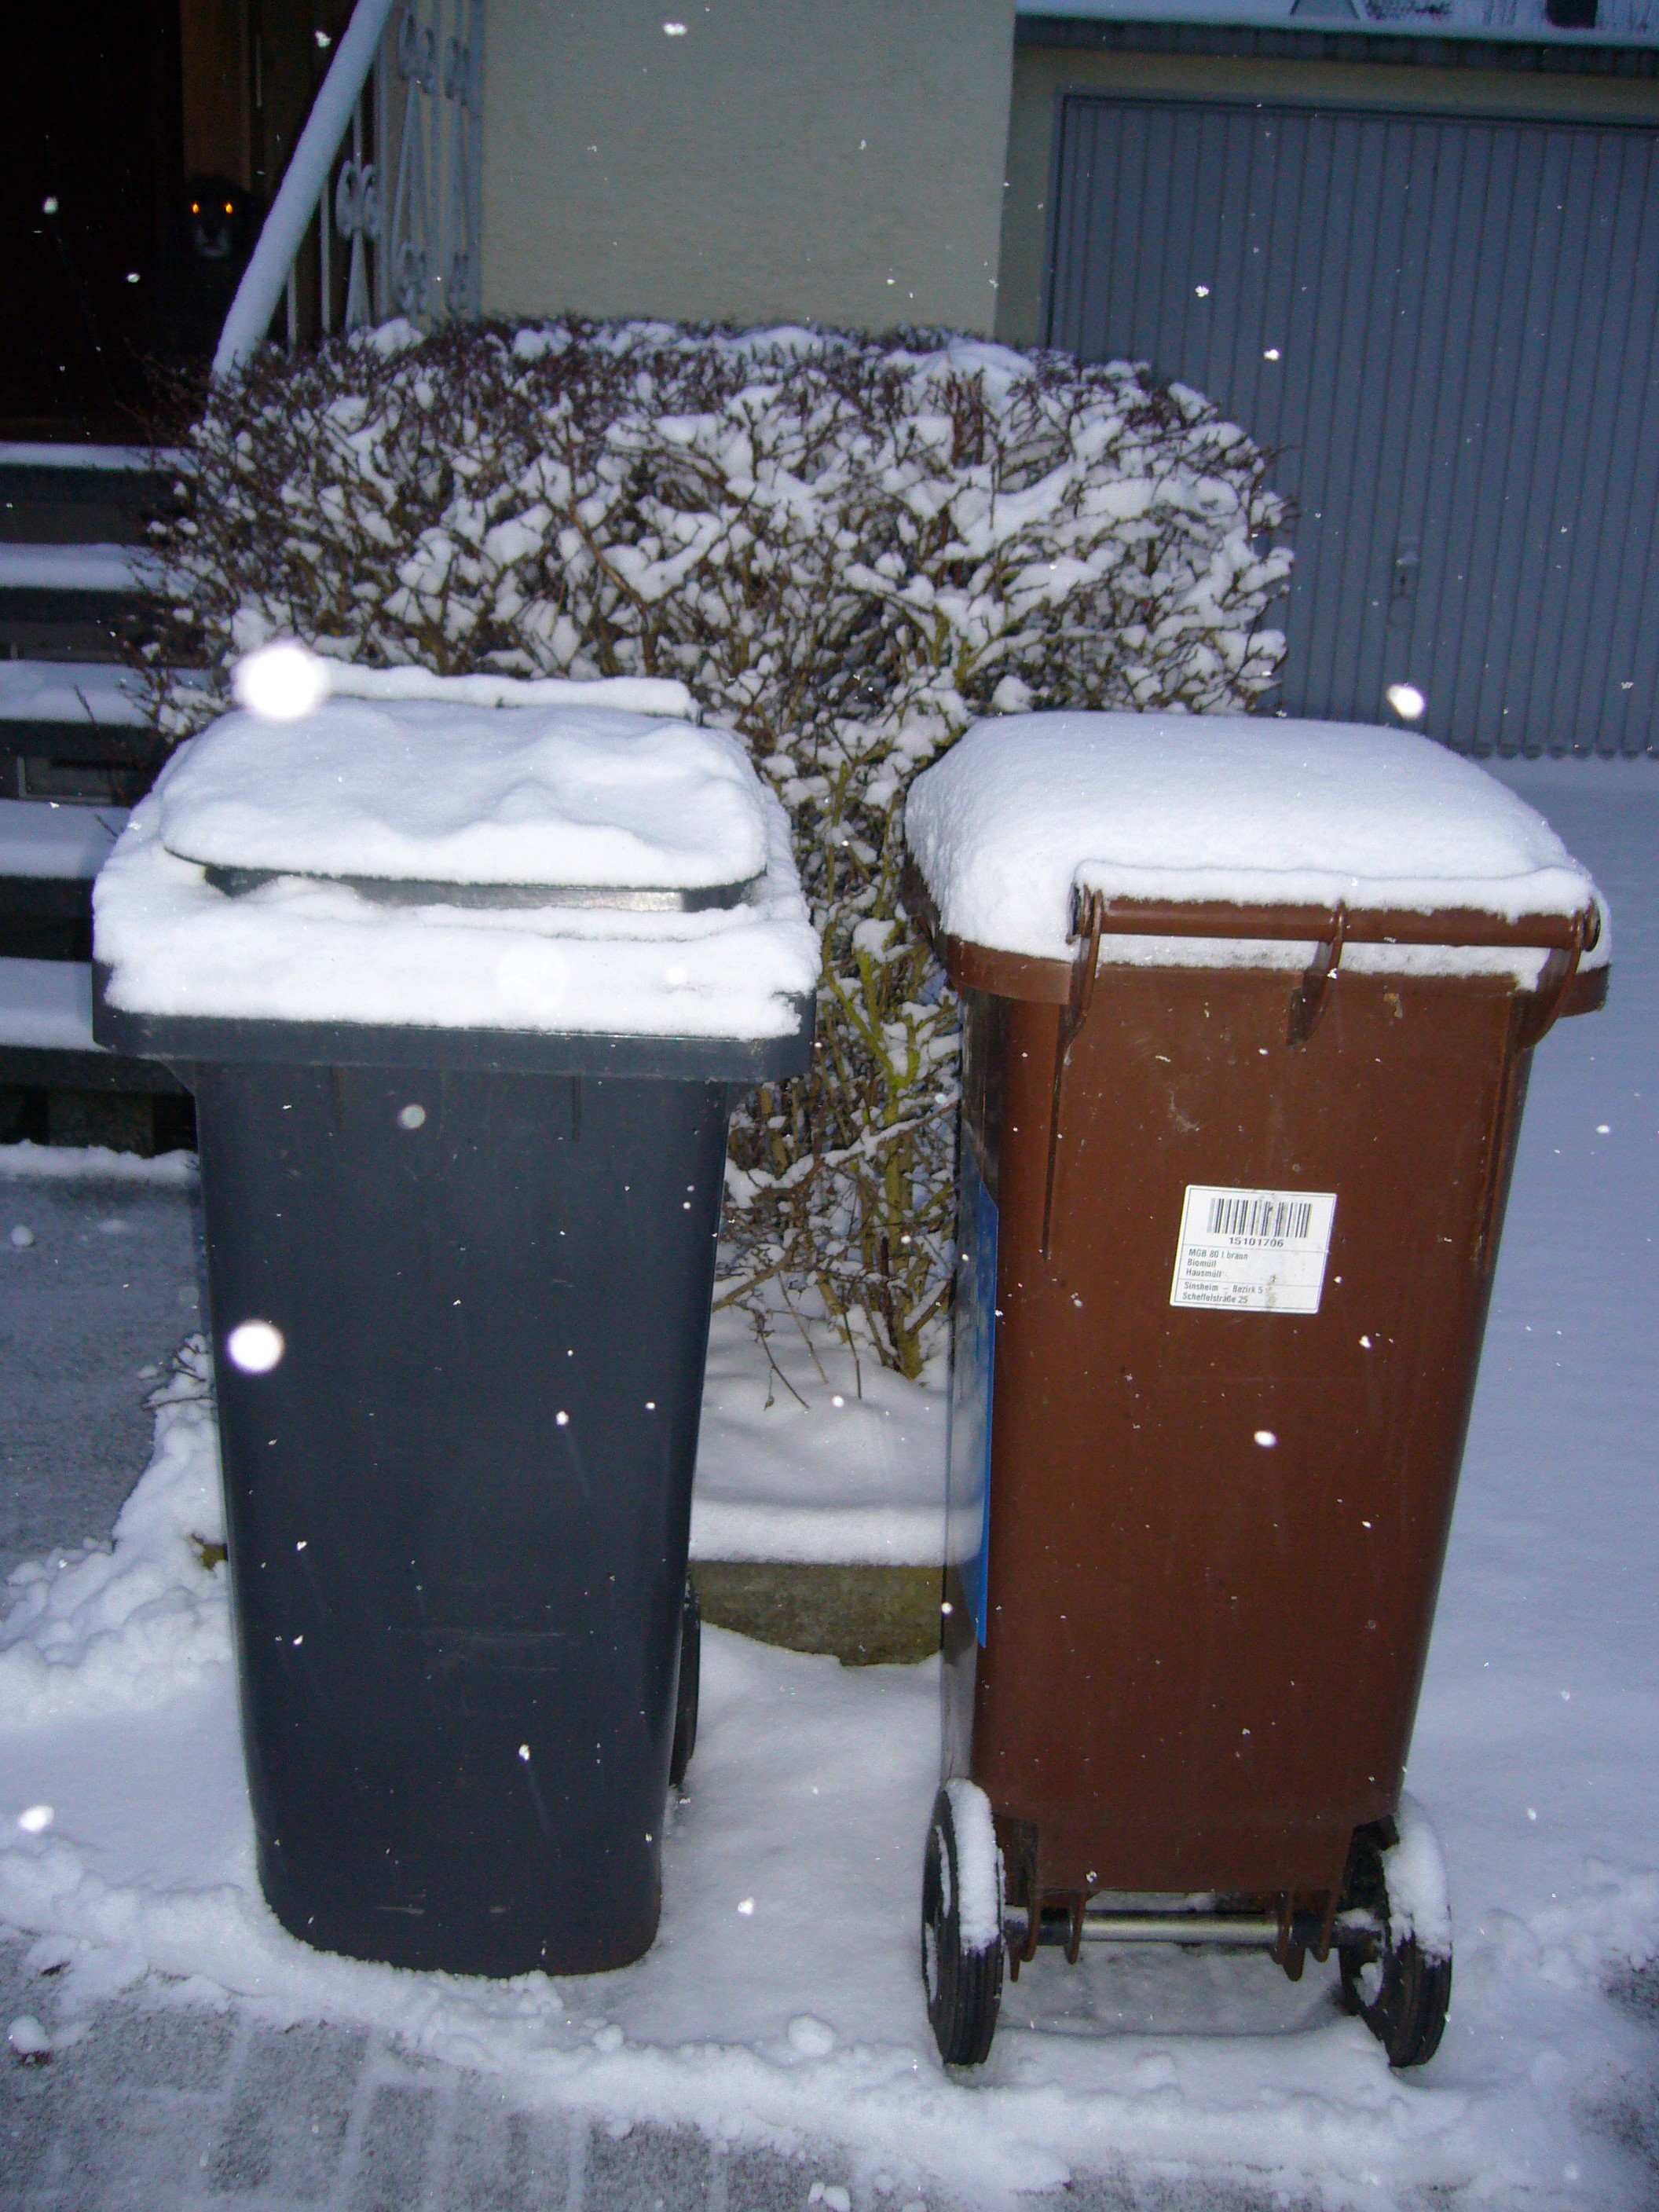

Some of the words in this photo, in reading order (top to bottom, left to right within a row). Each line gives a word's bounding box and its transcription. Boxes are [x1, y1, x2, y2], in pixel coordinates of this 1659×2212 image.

[1229, 1237, 1283, 1247] 15101706
[1188, 1248, 1206, 1257] MGB
[1227, 1251, 1248, 1260] braun
[1187, 1258, 1216, 1267] Biomüll
[1186, 1268, 1222, 1277] Hausmüll
[1184, 1282, 1218, 1291] Sinsheim
[1232, 1285, 1255, 1293] Bezirk
[1183, 1292, 1235, 1303] Scheffelstraße
